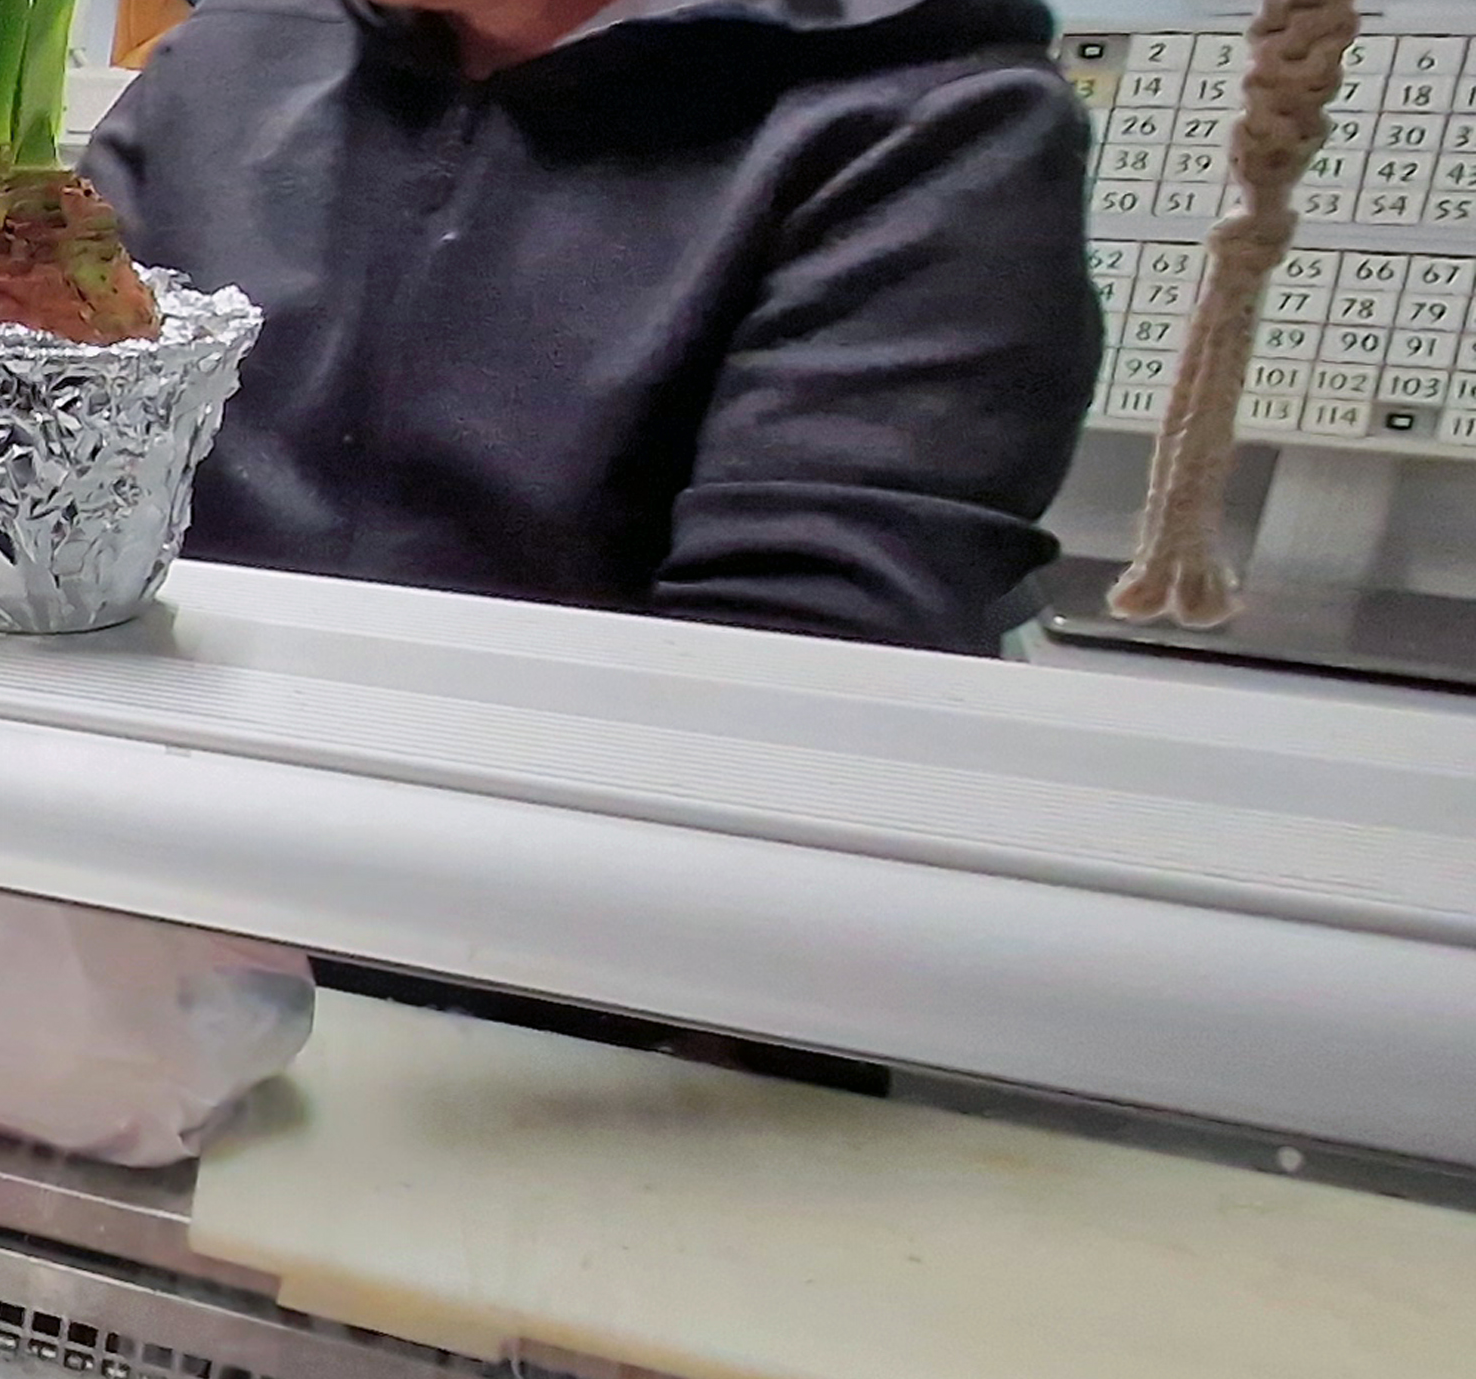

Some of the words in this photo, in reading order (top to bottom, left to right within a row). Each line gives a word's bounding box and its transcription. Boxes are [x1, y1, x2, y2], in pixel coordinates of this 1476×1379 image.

[1148, 42, 1166, 62] 2
[1216, 44, 1232, 67] 3
[1347, 45, 1366, 66] 5
[1416, 50, 1436, 71] 6
[1132, 76, 1162, 97] 14
[1198, 78, 1227, 101] 15
[1402, 84, 1433, 107] 18
[1121, 115, 1157, 136] 26
[1184, 118, 1219, 138] 27
[1388, 125, 1427, 147] 30
[1114, 150, 1150, 171] 38
[1176, 153, 1212, 173] 39
[1308, 157, 1344, 178] 41
[1377, 160, 1419, 183] 42
[1102, 191, 1137, 212] 50
[1166, 192, 1196, 212] 51
[1304, 193, 1340, 215] 53
[1371, 194, 1408, 217] 54
[1434, 198, 1472, 221] 55
[1151, 252, 1190, 275] 63
[1286, 256, 1323, 280] 65
[1356, 258, 1395, 282] 66
[1422, 262, 1461, 285] 67
[1148, 284, 1180, 305] 75
[1277, 291, 1311, 312] 77
[1341, 297, 1376, 320] 78
[1409, 301, 1448, 323] 79
[1135, 321, 1171, 343] 87
[1267, 327, 1305, 349] 89
[1341, 331, 1380, 353] 90
[1406, 336, 1438, 357] 91
[1125, 357, 1164, 379] 99
[1254, 365, 1299, 388] 101
[1317, 370, 1368, 393] 102
[1390, 375, 1441, 398] 103
[1120, 390, 1154, 412] 111
[1251, 398, 1289, 420] 113
[1316, 405, 1358, 426] 114
